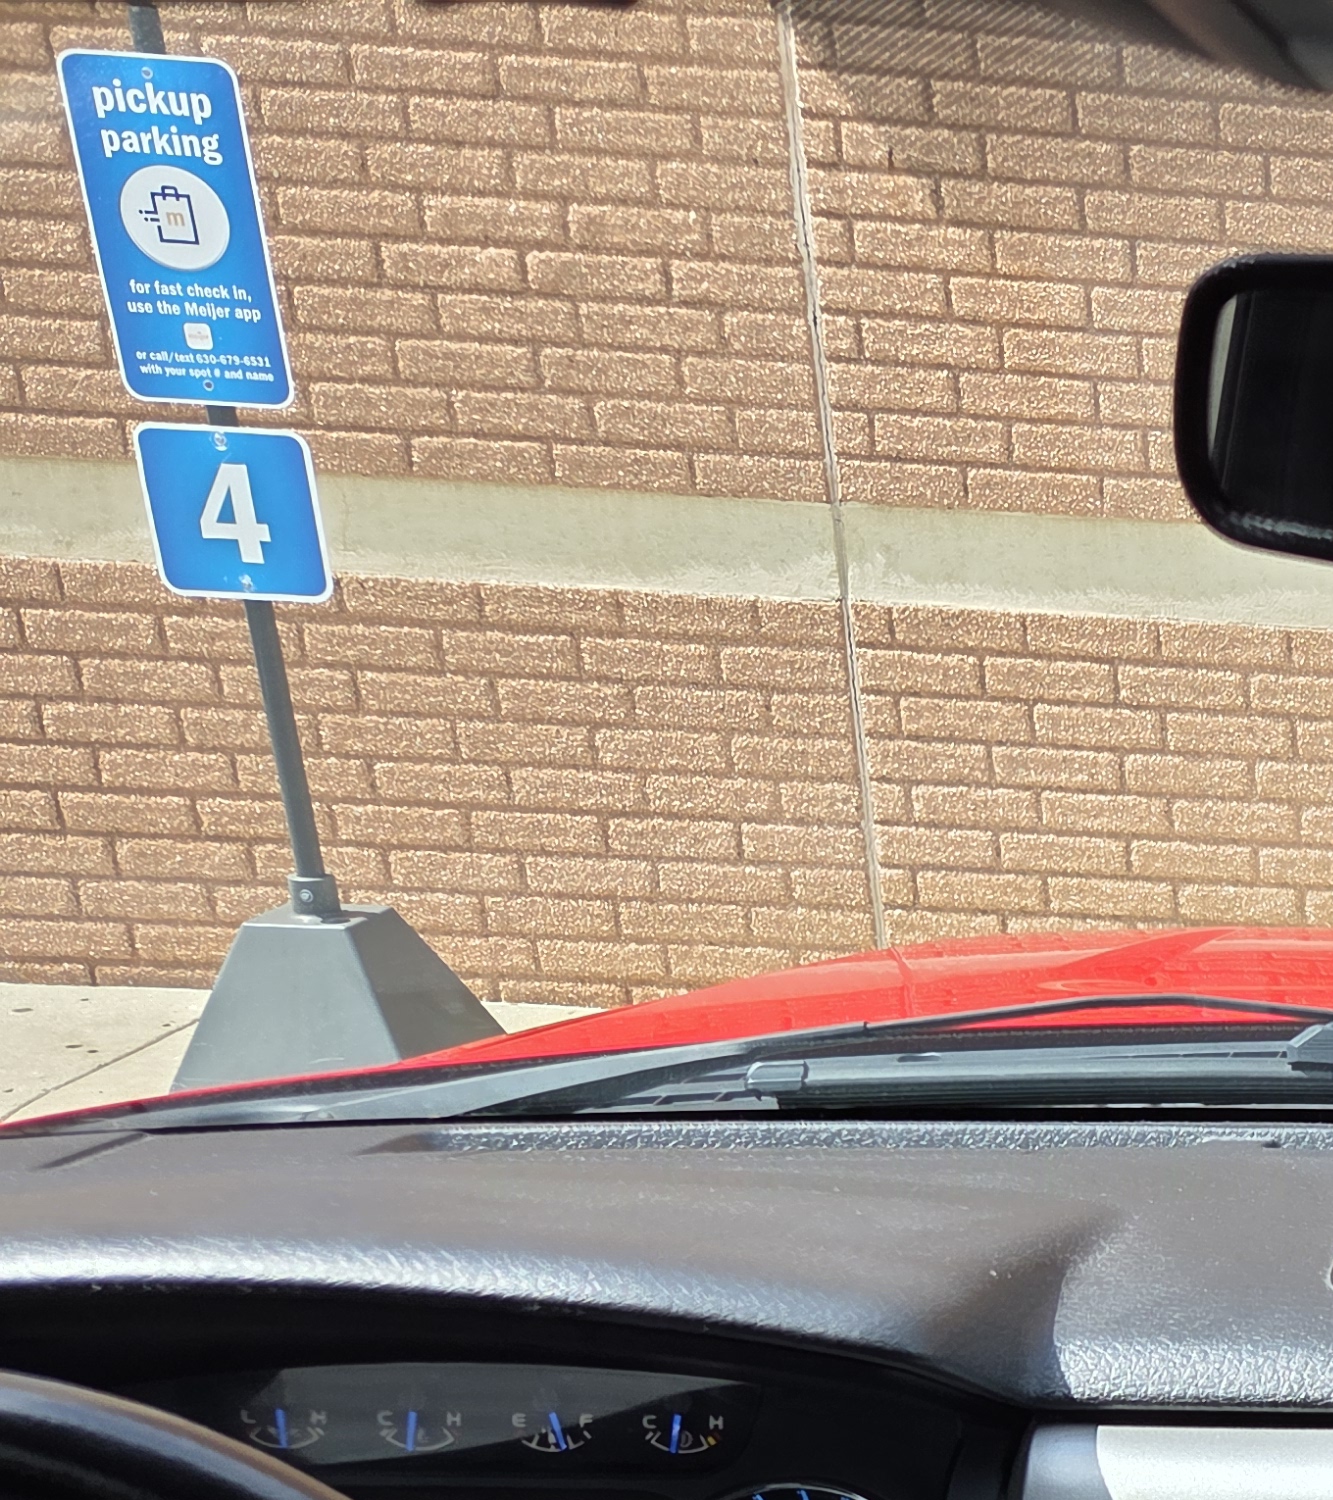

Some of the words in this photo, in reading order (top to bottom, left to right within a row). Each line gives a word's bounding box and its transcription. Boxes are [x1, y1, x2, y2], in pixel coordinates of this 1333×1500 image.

[92, 78, 212, 125] pickup
[100, 125, 223, 165] parking
[129, 279, 150, 294] for
[154, 280, 183, 296] fast
[187, 283, 230, 299] check
[232, 285, 252, 302] in,
[127, 301, 153, 314] use
[157, 301, 181, 315] the
[185, 302, 231, 320] Meijer
[235, 307, 262, 323] app
[136, 351, 147, 360] or
[196, 354, 271, 368] 630-679-6531
[139, 364, 163, 375] with
[164, 367, 186, 378] your
[189, 367, 212, 379] spot
[224, 369, 243, 380] and
[245, 372, 275, 382] name
[200, 463, 272, 564] 4
[377, 1411, 392, 1426] C
[447, 1412, 461, 1426] H
[512, 1413, 526, 1426] E
[580, 1413, 594, 1427] F
[643, 1415, 657, 1429] C
[709, 1416, 724, 1429] H
